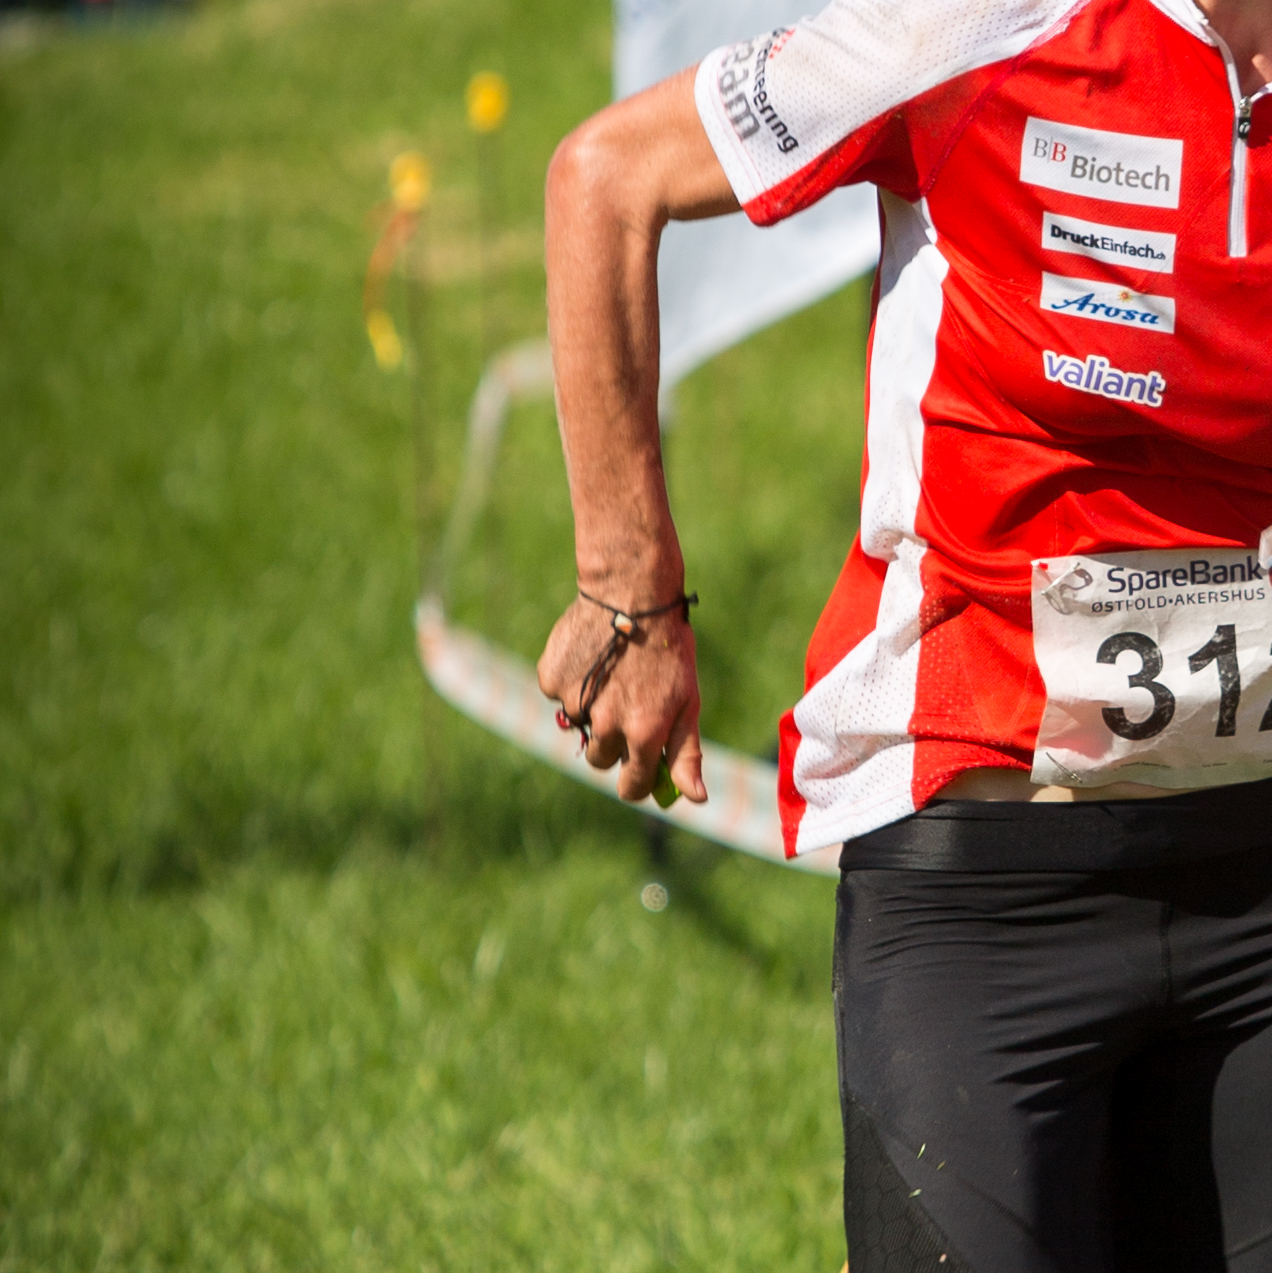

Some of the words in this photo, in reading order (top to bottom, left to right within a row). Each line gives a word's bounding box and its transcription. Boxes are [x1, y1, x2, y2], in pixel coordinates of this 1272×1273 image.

[1070, 155, 1170, 191] Biotech
[1050, 224, 1166, 260] DruckEinfach.ch
[1051, 293, 1159, 325] Arosa
[1047, 354, 1162, 403] valiant
[1108, 556, 1263, 595] SpareBank
